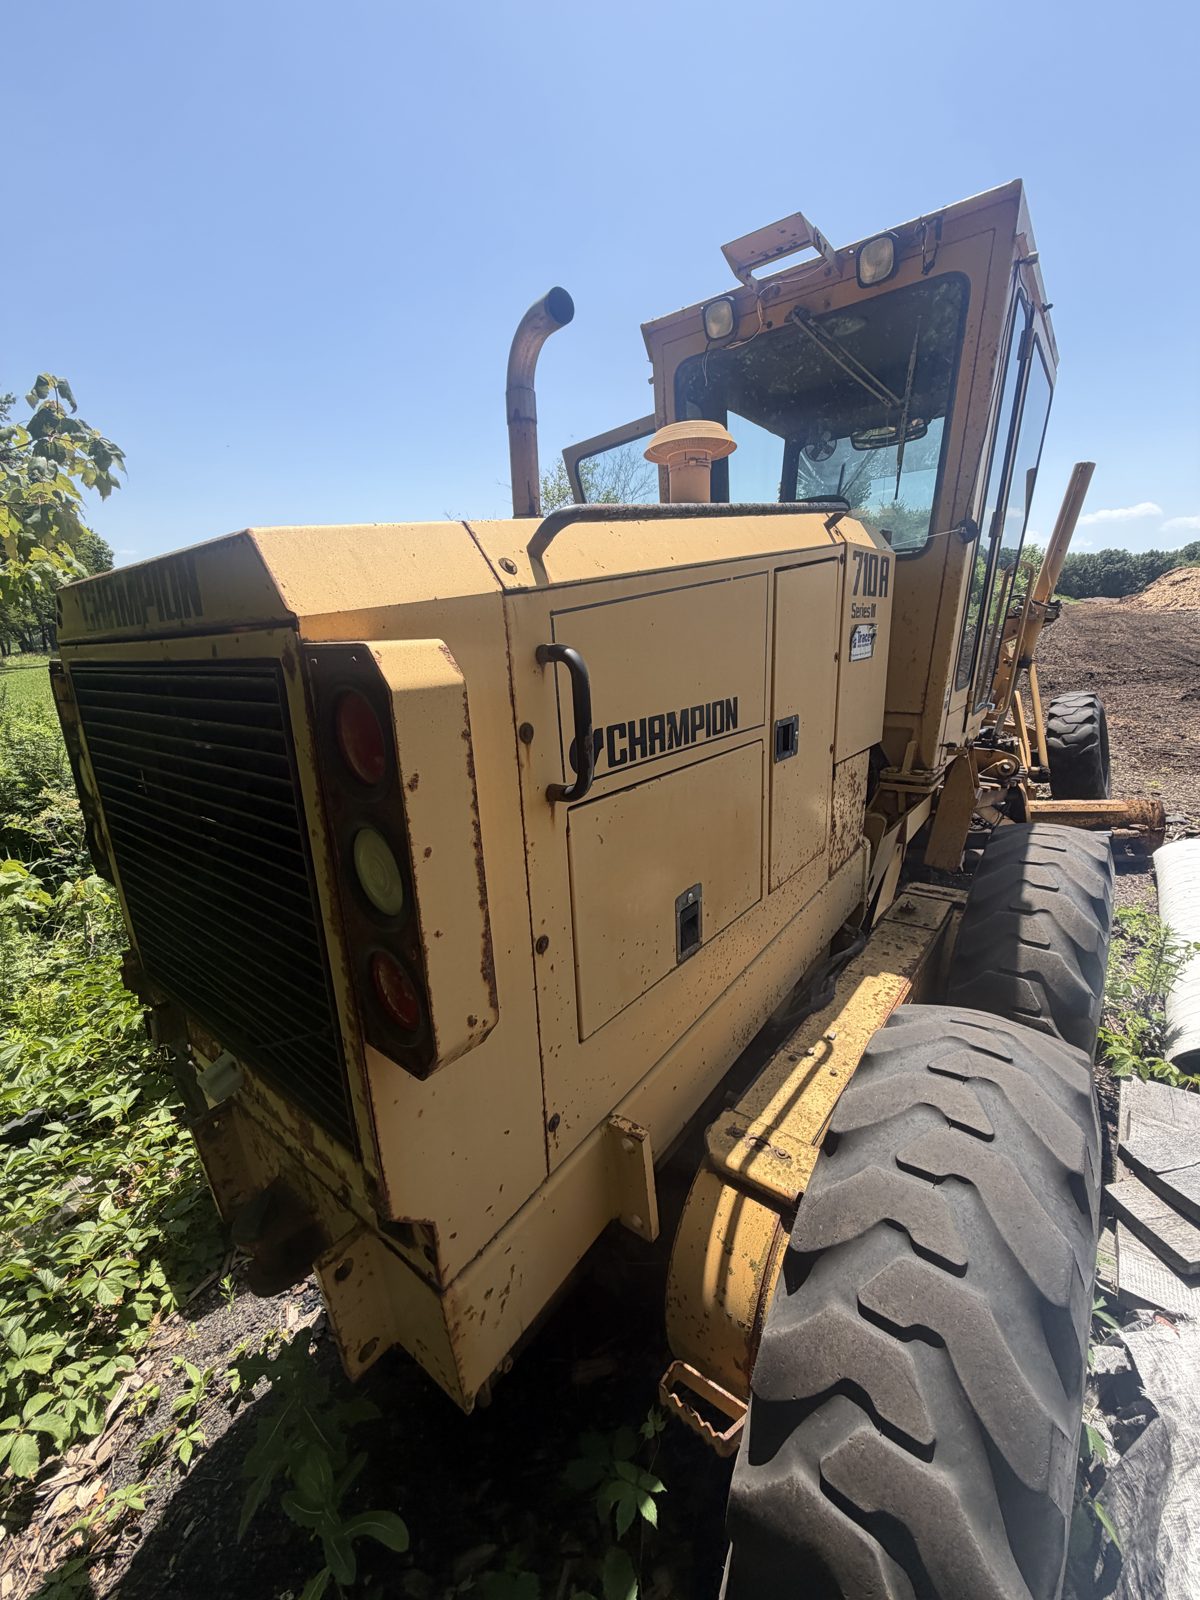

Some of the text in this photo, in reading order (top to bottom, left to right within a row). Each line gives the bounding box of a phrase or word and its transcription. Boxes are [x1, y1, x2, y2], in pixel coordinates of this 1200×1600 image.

[78, 554, 203, 631] CHAMPION
[852, 550, 890, 598] 710A
[851, 602, 870, 618] Series
[606, 697, 738, 768] CHAMPION
